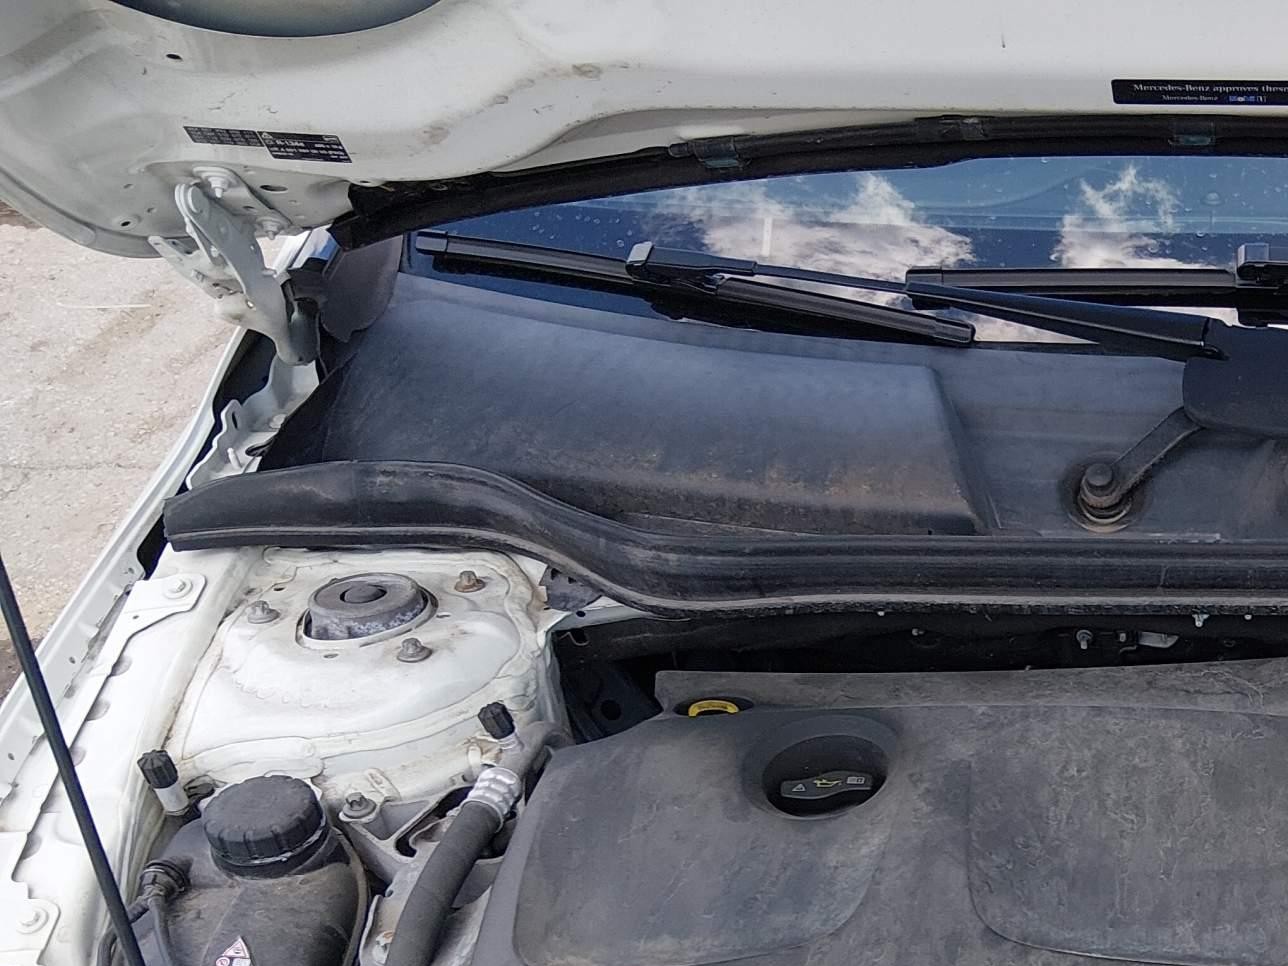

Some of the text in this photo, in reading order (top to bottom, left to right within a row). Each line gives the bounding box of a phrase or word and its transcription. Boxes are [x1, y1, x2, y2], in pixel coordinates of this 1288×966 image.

[1133, 83, 1210, 92] Mercedes-Benz
[1213, 84, 1259, 93] approves
[1262, 84, 1288, 92] these
